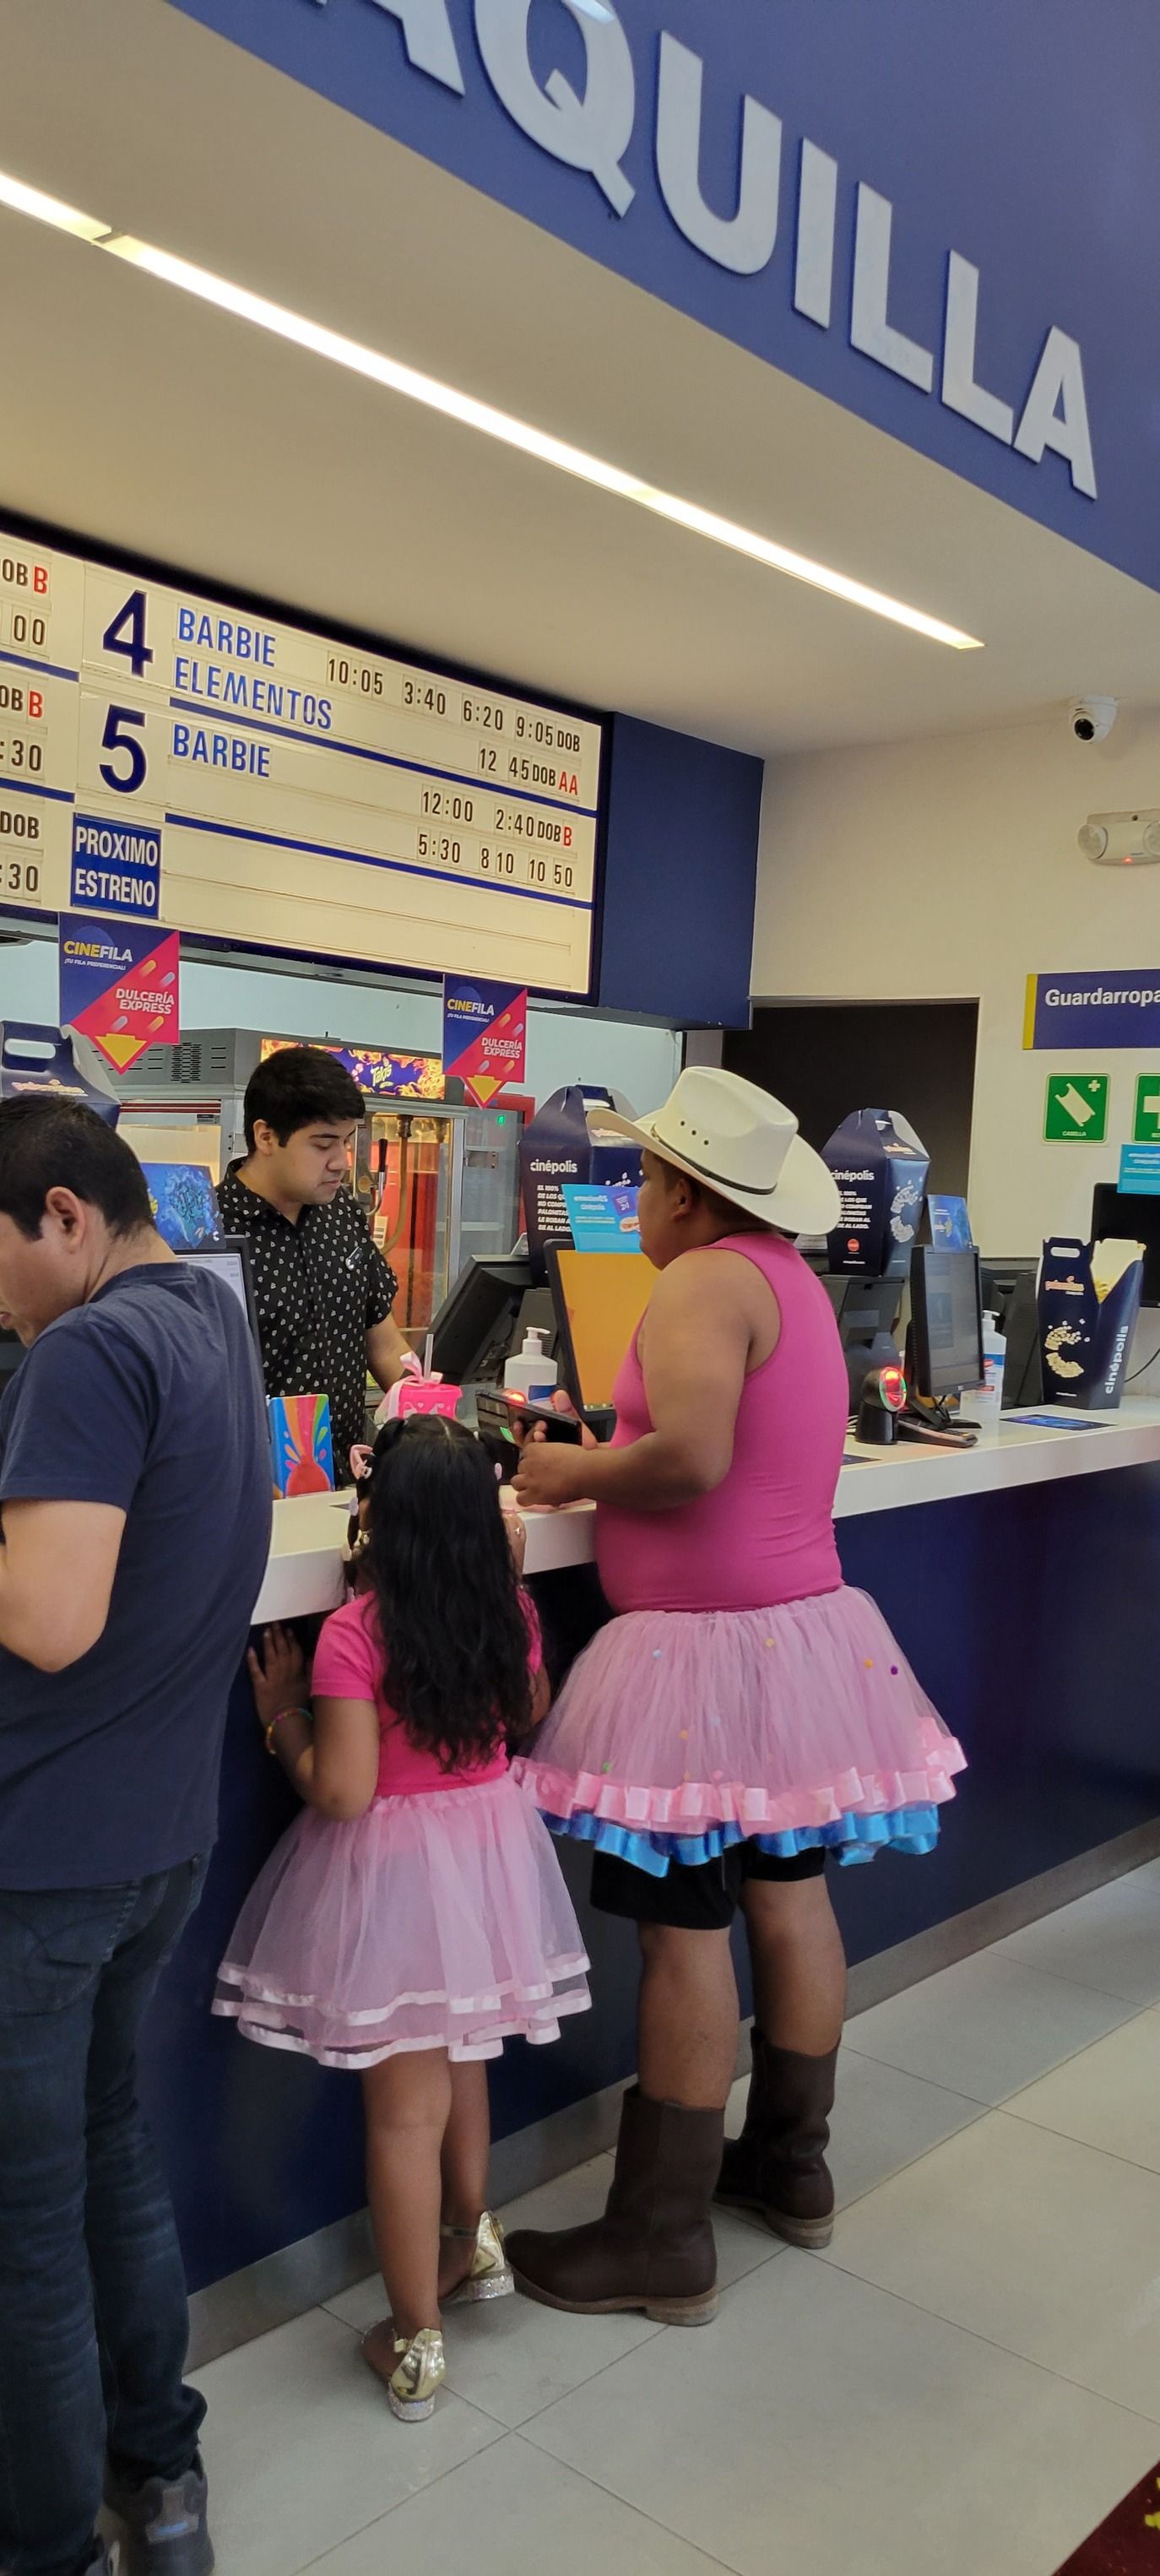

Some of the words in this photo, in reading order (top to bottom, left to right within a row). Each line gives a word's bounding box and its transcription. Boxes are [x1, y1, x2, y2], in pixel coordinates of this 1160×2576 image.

[34, 567, 48, 594] B
[102, 589, 154, 678] 4
[179, 608, 276, 667] BARBIE
[328, 659, 383, 695] 10:05
[404, 682, 446, 714] 3:40
[463, 700, 503, 730] 6:20
[516, 716, 554, 746] 9:05
[557, 730, 580, 752] DOB
[29, 691, 42, 718] B
[175, 657, 332, 729] ELEMENTOS
[480, 748, 496, 772] 12
[532, 764, 556, 786] DOB
[558, 772, 578, 795] AA
[100, 704, 147, 793] 5
[173, 724, 270, 778] BARBIE
[423, 791, 473, 822] 12:00
[496, 809, 534, 837] 2:40
[537, 821, 561, 843] DOB
[563, 827, 572, 847] B
[75, 826, 159, 867] PROXIMO
[419, 833, 460, 863] 5:30
[74, 868, 155, 907] ESTRENO
[63, 941, 133, 962] CINEFILA
[116, 988, 175, 1006] DULCERÍA
[119, 1000, 172, 1015] EXPRESS
[447, 999, 495, 1016] CINEFILA
[1045, 987, 1160, 1007] Guardarropa
[481, 1038, 523, 1051] DULCERÍA
[484, 1047, 520, 1059] EXPRESS
[530, 1159, 578, 1174] cinépolis
[831, 1169, 875, 1182] cinépolis
[1104, 1325, 1130, 1394] cinépolis
